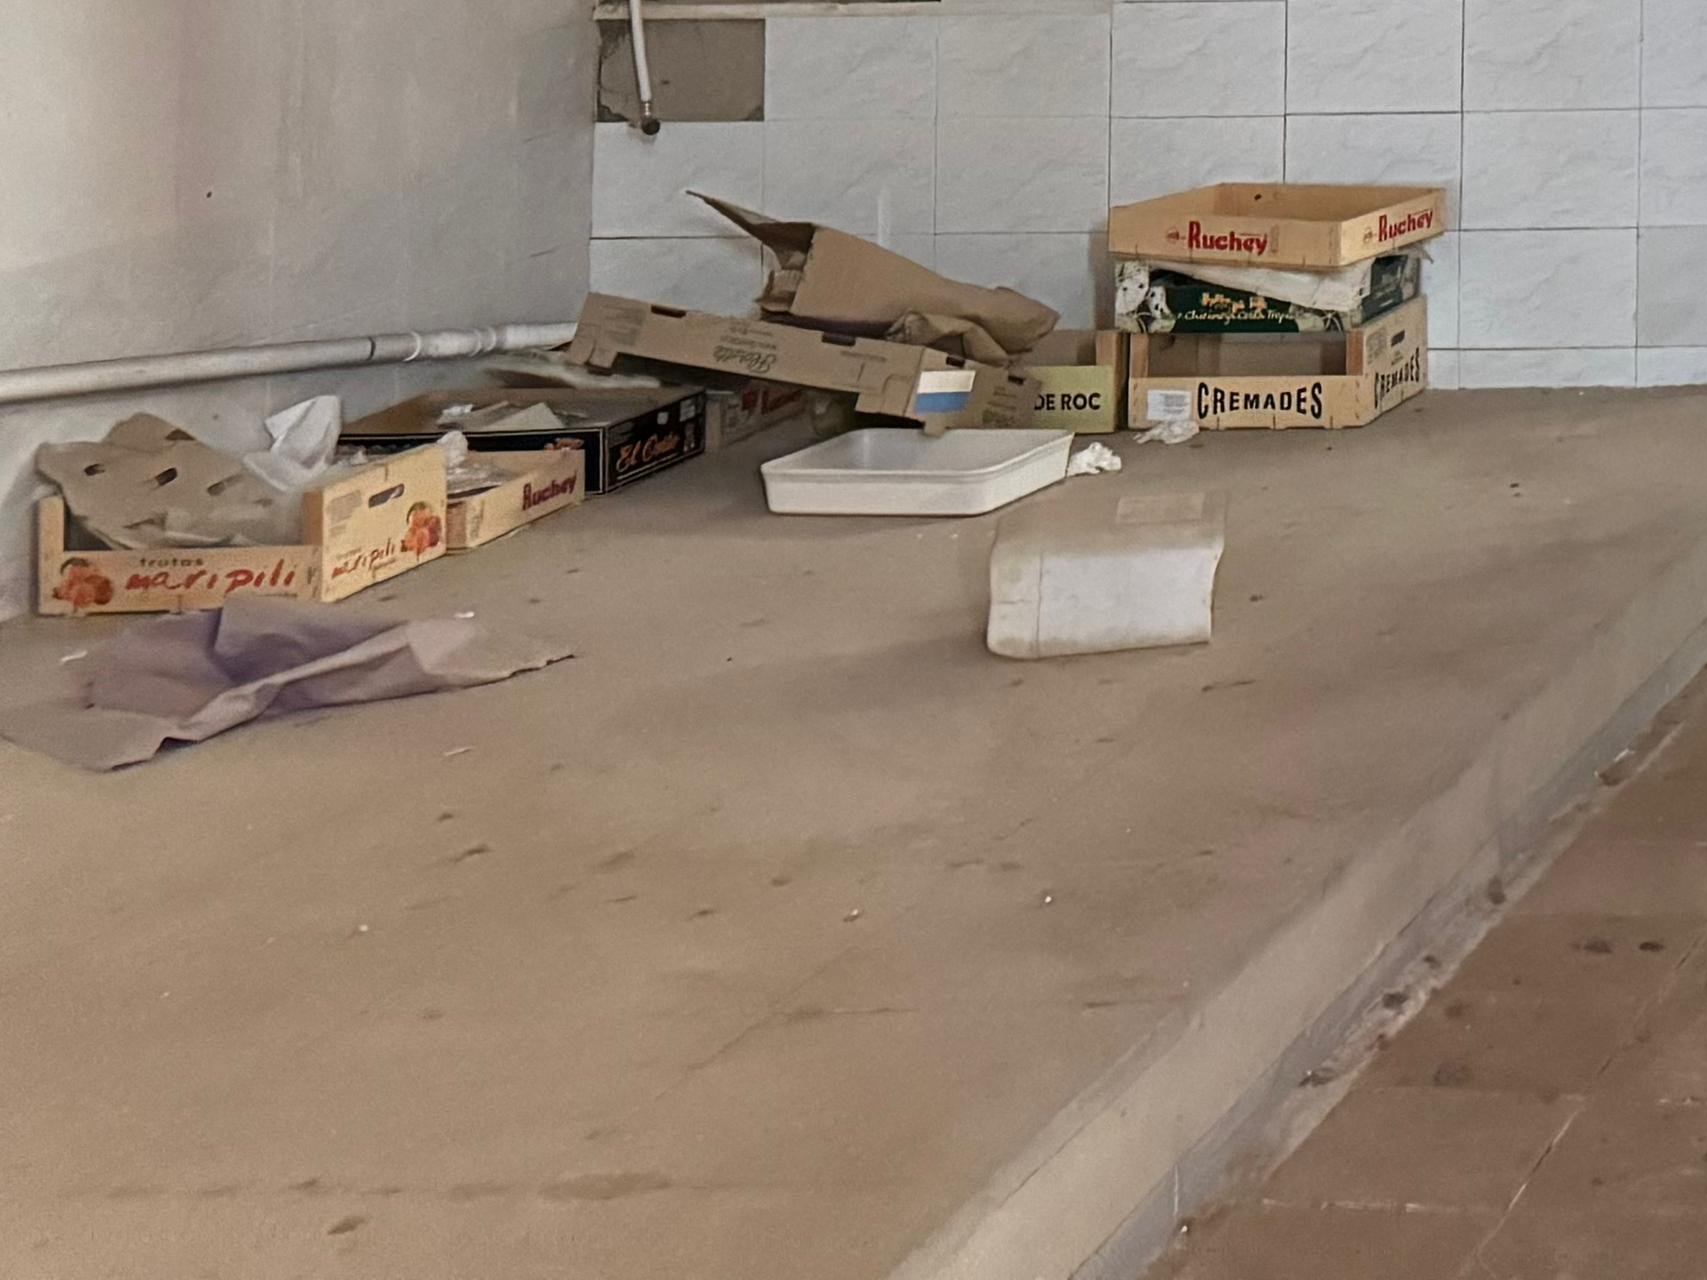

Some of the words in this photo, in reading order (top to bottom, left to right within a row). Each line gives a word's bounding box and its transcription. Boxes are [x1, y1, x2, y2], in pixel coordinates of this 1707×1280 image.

[1188, 220, 1268, 256] Ruchey
[1377, 209, 1434, 242] Ruchey
[1374, 346, 1420, 410] CREMADES
[1060, 392, 1102, 411] ROC
[1197, 381, 1324, 420] CREMADES
